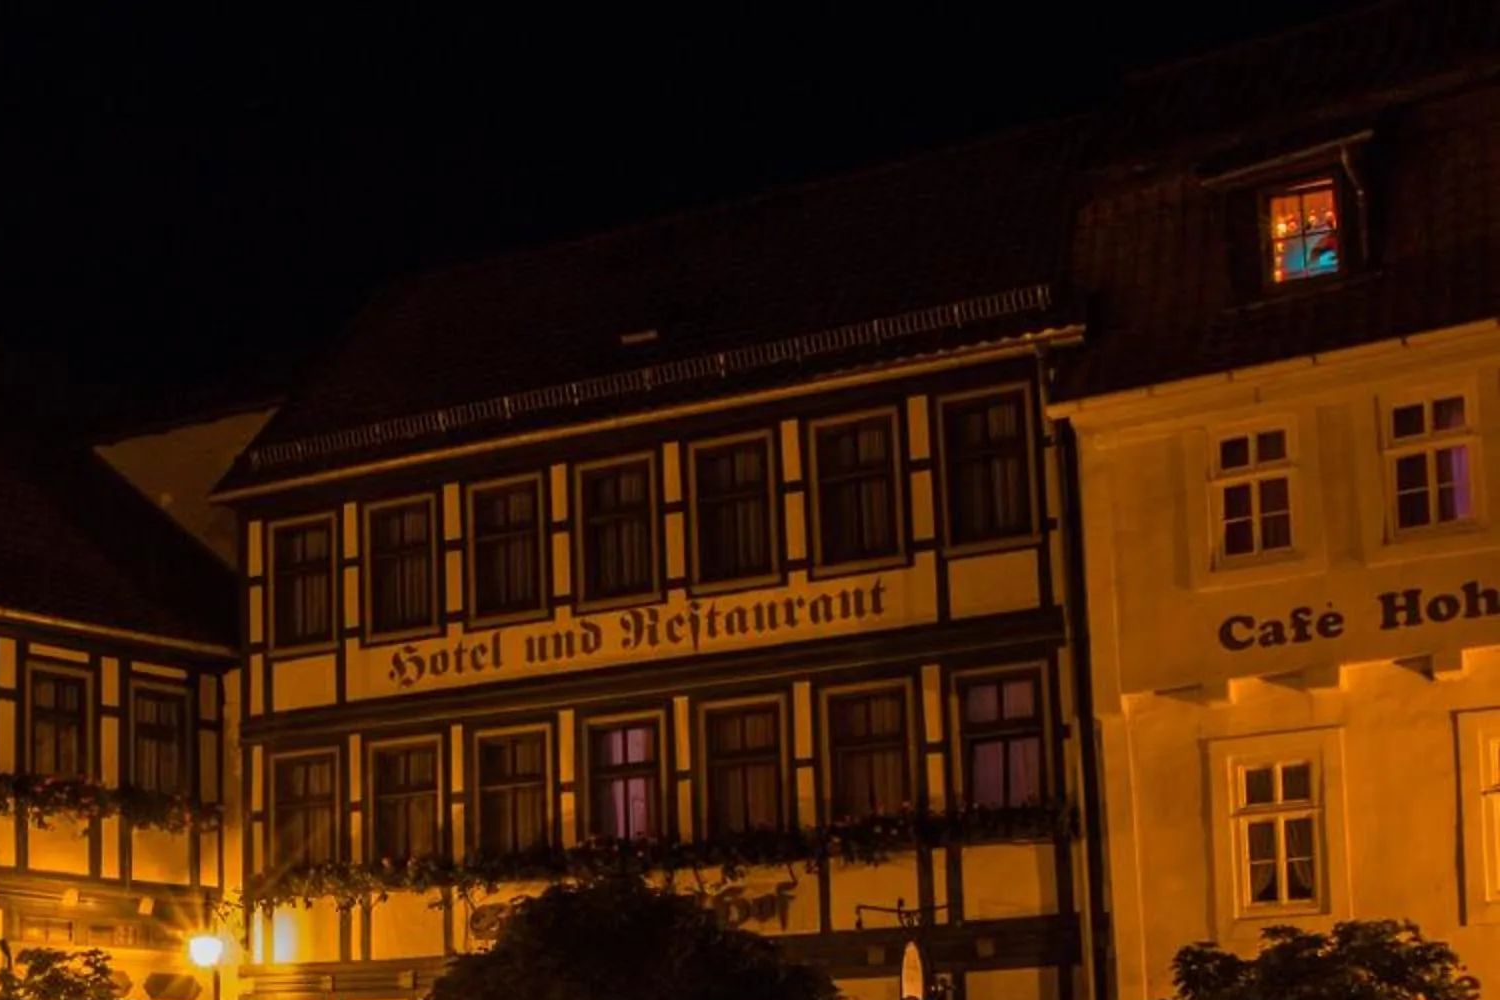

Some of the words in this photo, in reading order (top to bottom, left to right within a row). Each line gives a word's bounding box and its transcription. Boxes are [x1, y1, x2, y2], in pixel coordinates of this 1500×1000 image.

[387, 632, 504, 688] Hotel
[525, 620, 601, 665] und
[620, 578, 887, 653] Restaurant
[1217, 601, 1345, 651] Café
